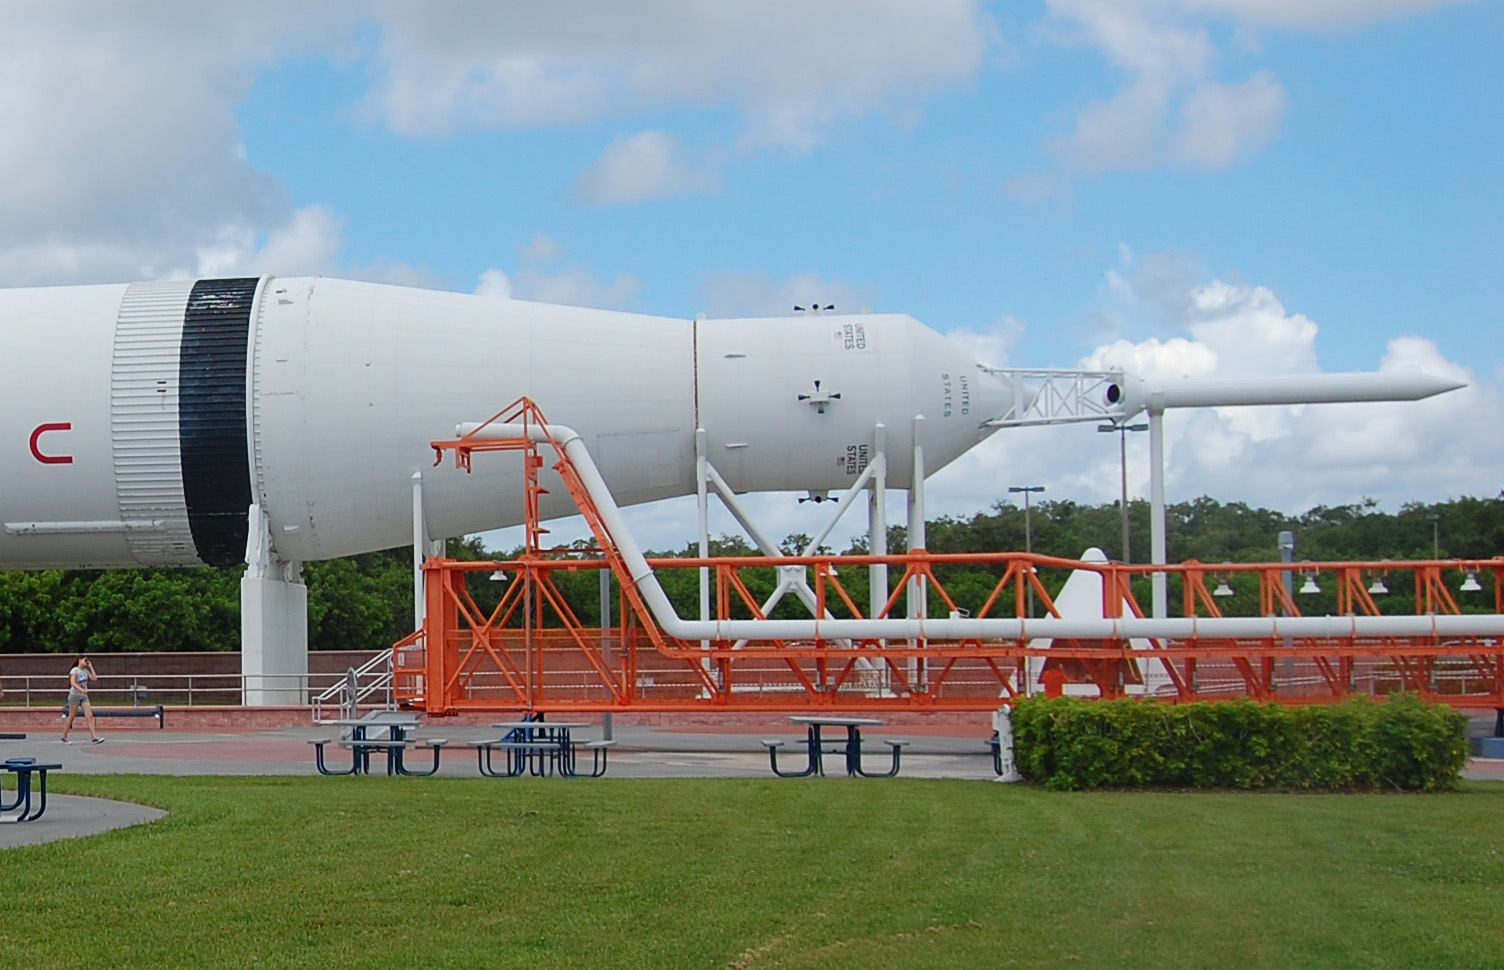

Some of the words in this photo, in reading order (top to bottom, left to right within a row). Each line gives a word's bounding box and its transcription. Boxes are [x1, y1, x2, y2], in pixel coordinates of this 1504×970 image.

[843, 324, 855, 350] STATES
[855, 323, 866, 350] UNITED
[942, 374, 952, 418] STATES
[959, 375, 970, 416] UNITED
[846, 445, 857, 475] STATES
